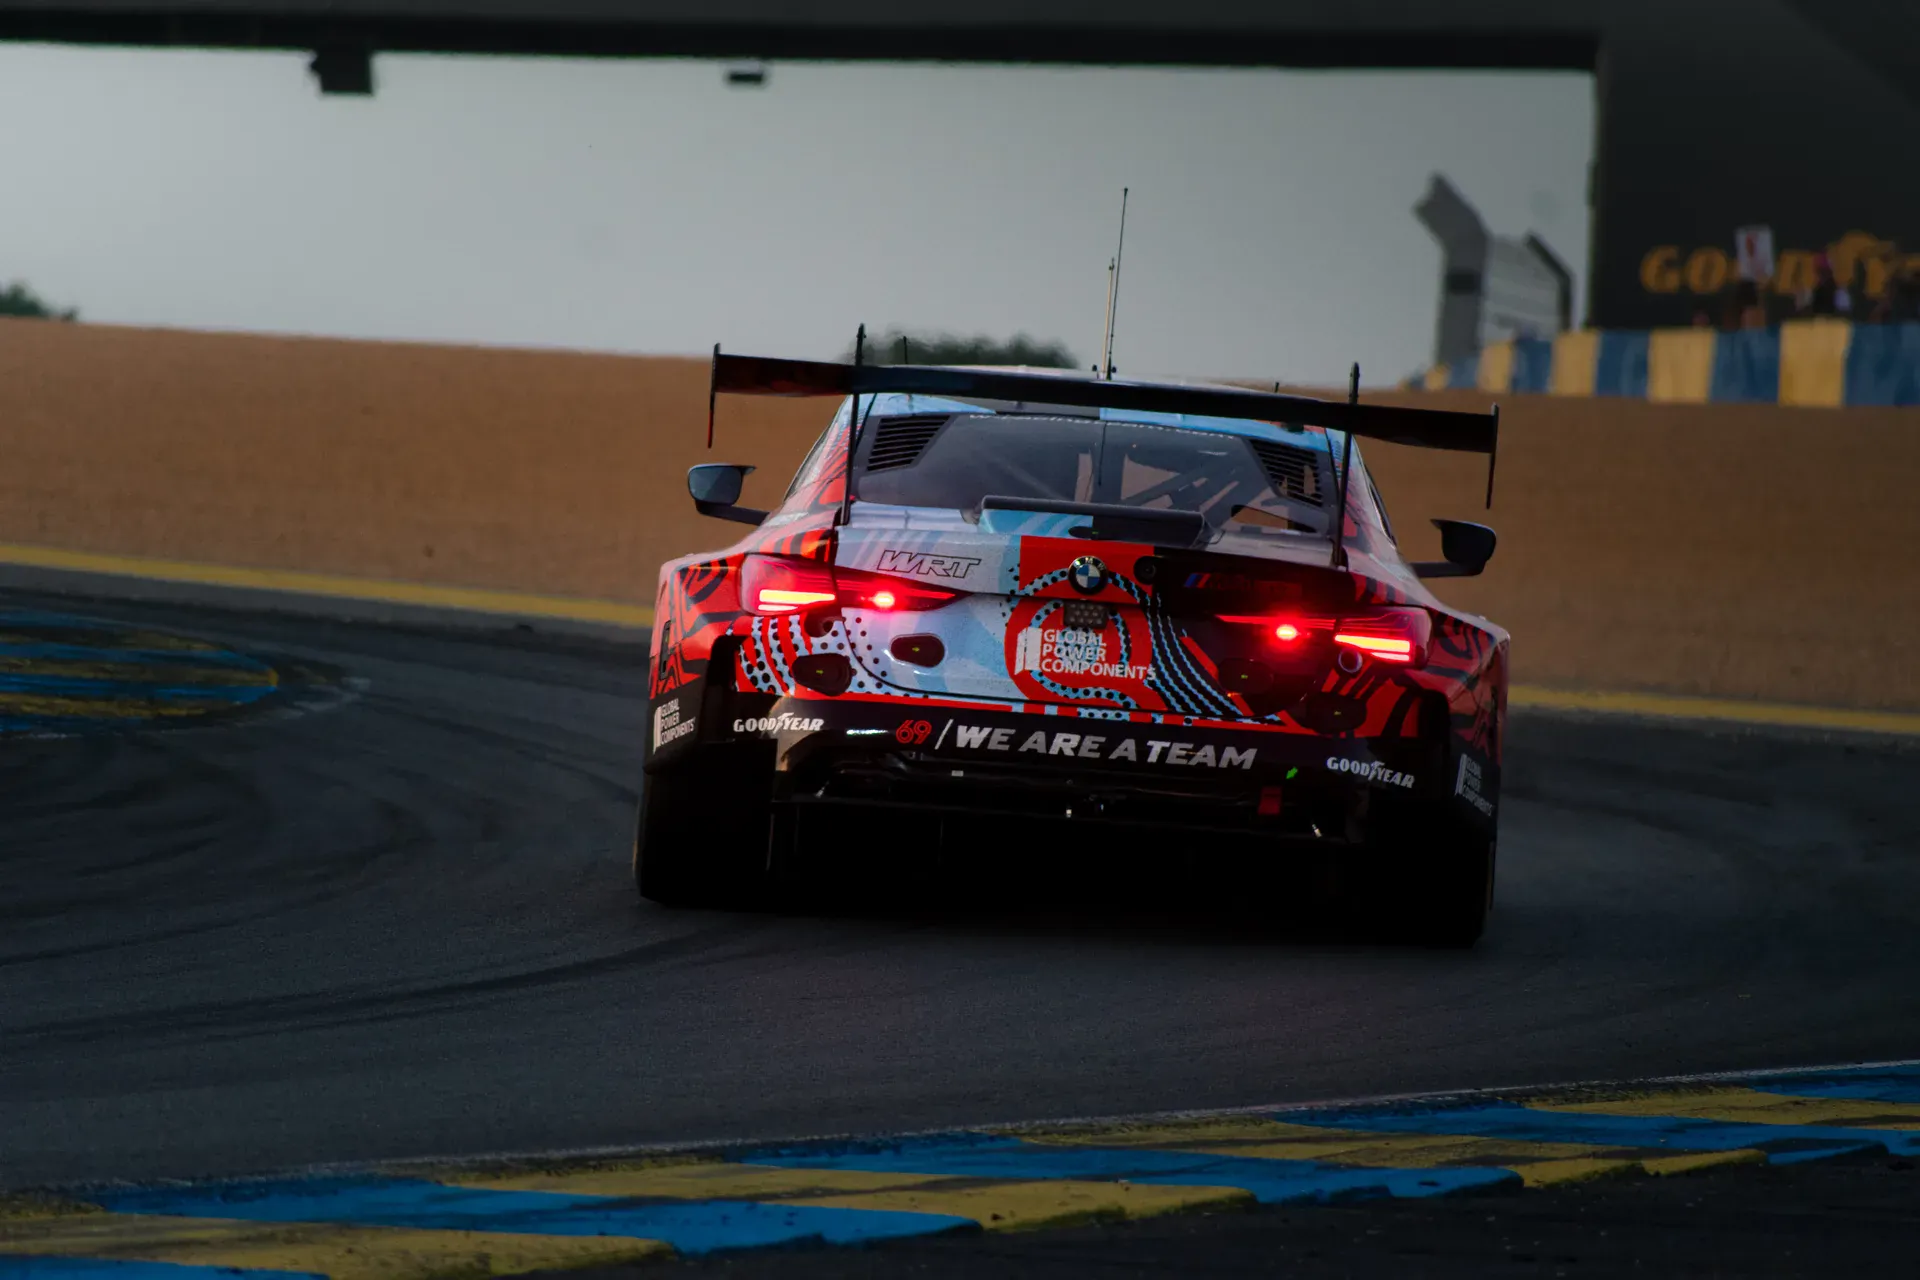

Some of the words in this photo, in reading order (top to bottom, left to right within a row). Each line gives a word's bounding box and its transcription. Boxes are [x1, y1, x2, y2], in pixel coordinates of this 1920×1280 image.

[877, 550, 981, 579] WRT
[1044, 629, 1107, 648] GLOBAL
[1042, 643, 1107, 662] POWER
[1041, 658, 1157, 681] COMPONENTS
[661, 698, 680, 717] GLOBAL
[661, 711, 680, 730] POWER
[733, 712, 824, 735] GOODYEAR
[896, 719, 932, 745] 69
[955, 725, 1015, 751] WE
[1019, 730, 1105, 758] ARE
[1108, 739, 1138, 761] A
[1146, 739, 1258, 770] TEAM
[1327, 756, 1416, 789] GOODYEAR
